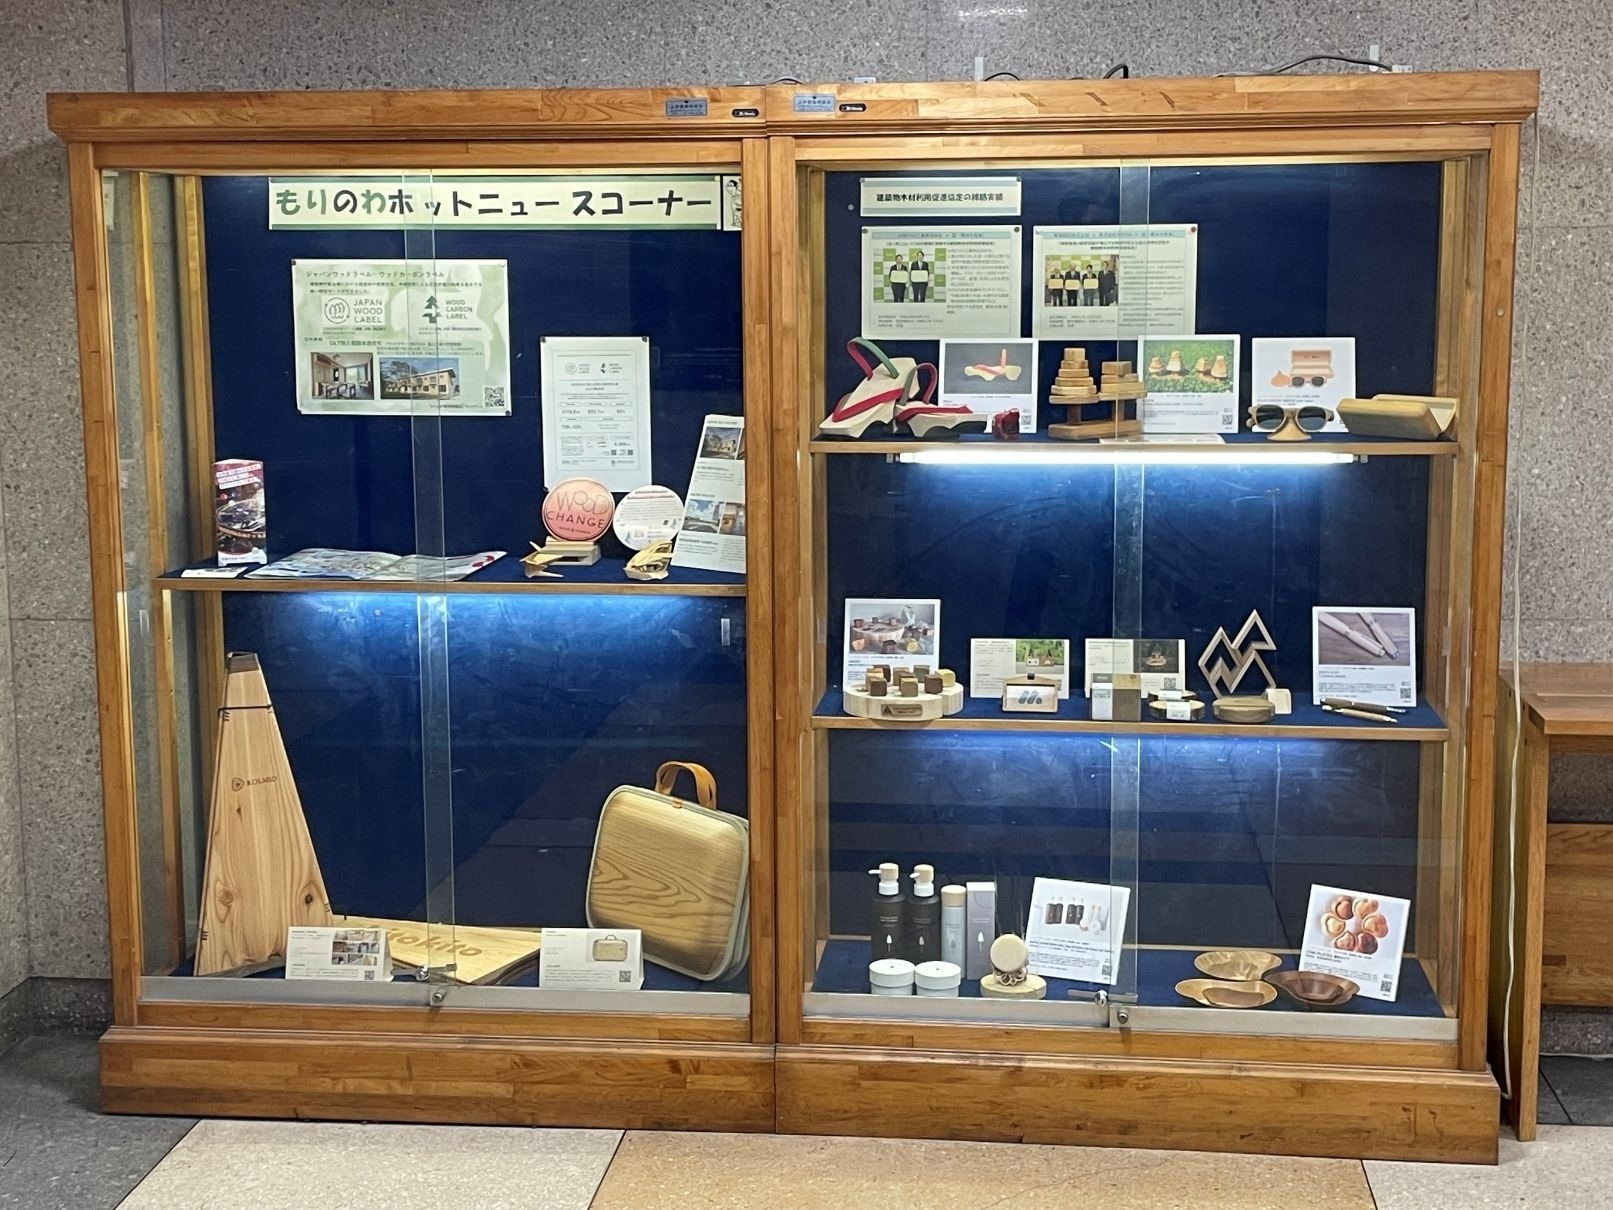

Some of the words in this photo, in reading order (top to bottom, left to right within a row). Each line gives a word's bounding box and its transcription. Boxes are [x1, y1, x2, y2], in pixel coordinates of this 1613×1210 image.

[354, 307, 383, 315] WOOD
[556, 490, 610, 514] WOOD
[546, 510, 607, 529] CHANGE
